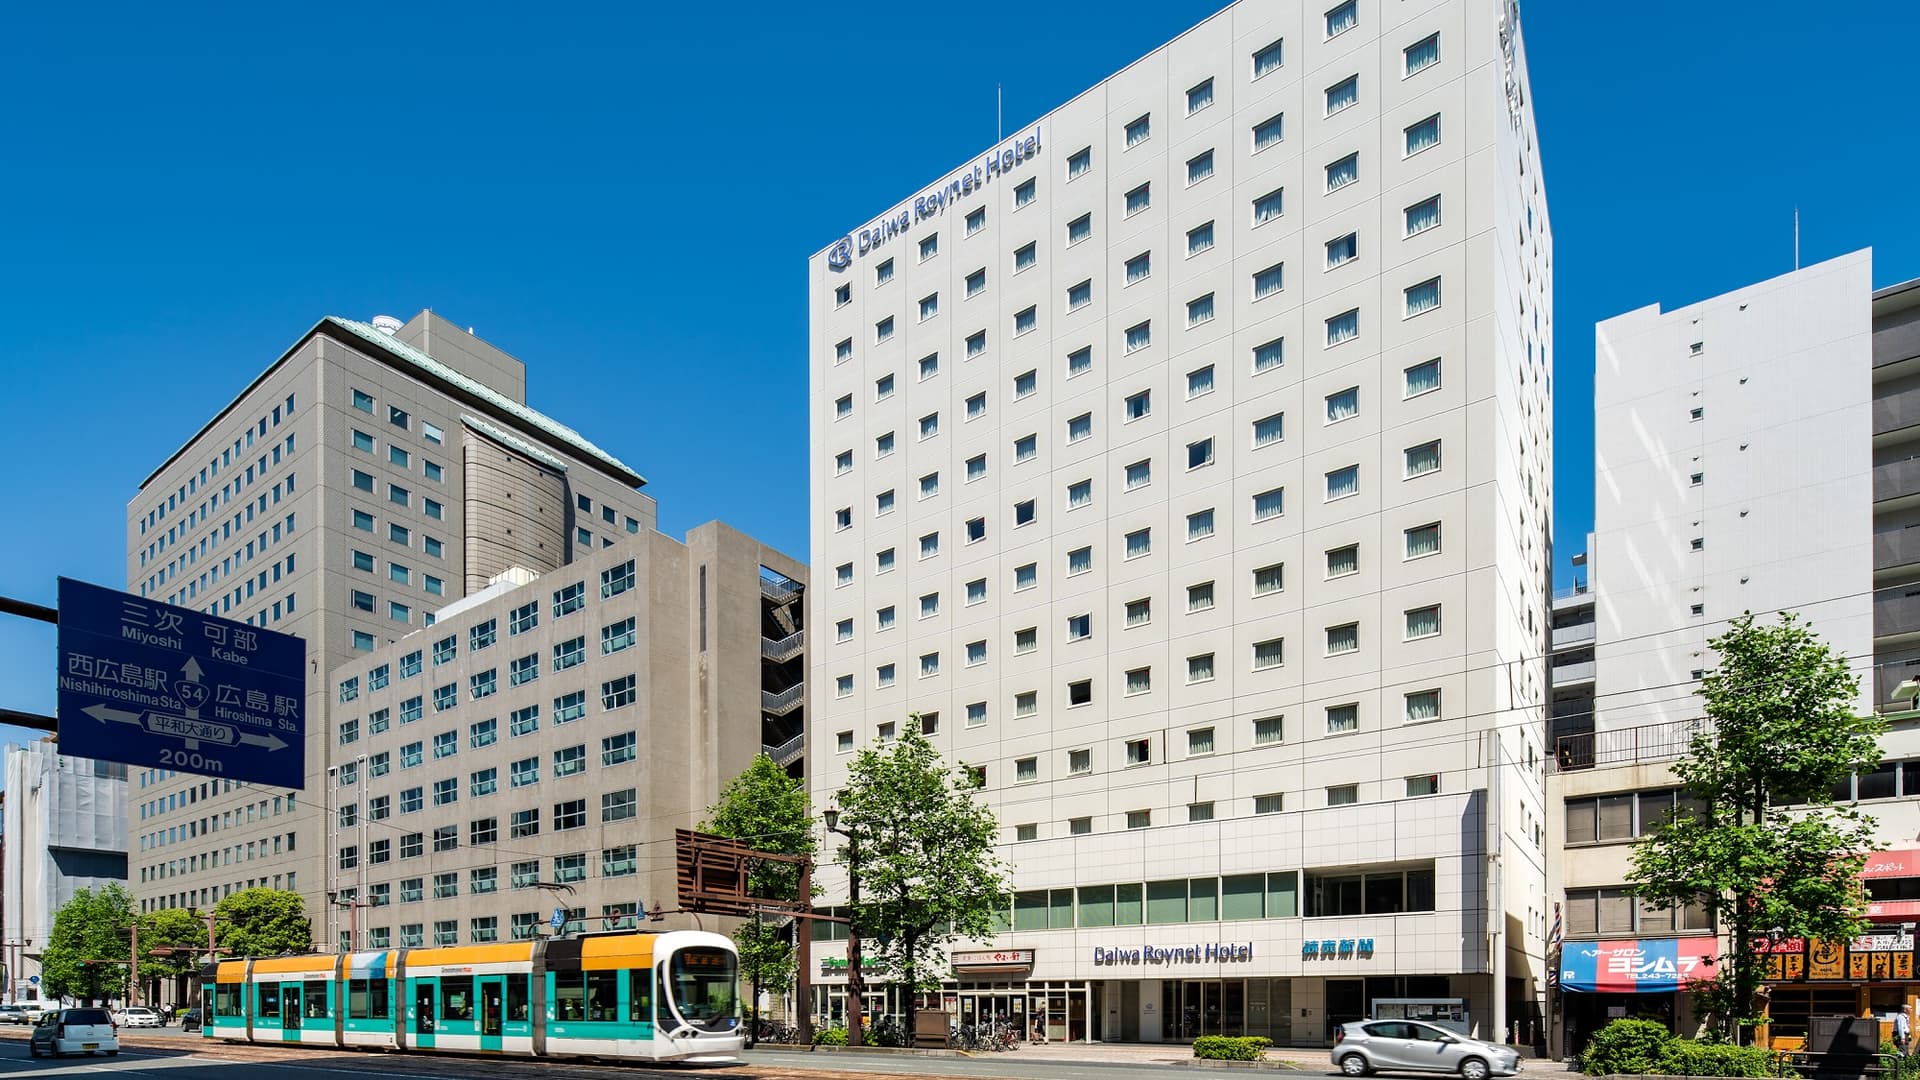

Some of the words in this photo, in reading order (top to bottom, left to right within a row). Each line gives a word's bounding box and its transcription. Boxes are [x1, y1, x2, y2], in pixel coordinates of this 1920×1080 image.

[858, 210, 909, 250] Daiwa
[914, 165, 982, 217] Roynet
[986, 126, 1042, 175] Hotel
[121, 601, 184, 635] 三次
[202, 621, 258, 652] 可部
[121, 626, 183, 650] Miyoshi
[211, 646, 248, 665] Kabe
[68, 652, 168, 693] 西広島駅
[60, 676, 159, 706] Nishihiroshima
[181, 686, 204, 701] 54
[215, 684, 299, 718] 広島駅
[154, 717, 226, 740] 平和大通り
[215, 706, 273, 728] Hiroshima
[278, 718, 299, 732] Sta.
[159, 749, 223, 772] 200m
[1094, 946, 1140, 963] Daiwa
[1143, 944, 1201, 966] Roynet
[1205, 941, 1252, 961] Hotel
[1581, 948, 1647, 957] ヘアーサロン
[1608, 956, 1699, 973] ヨシムラ
